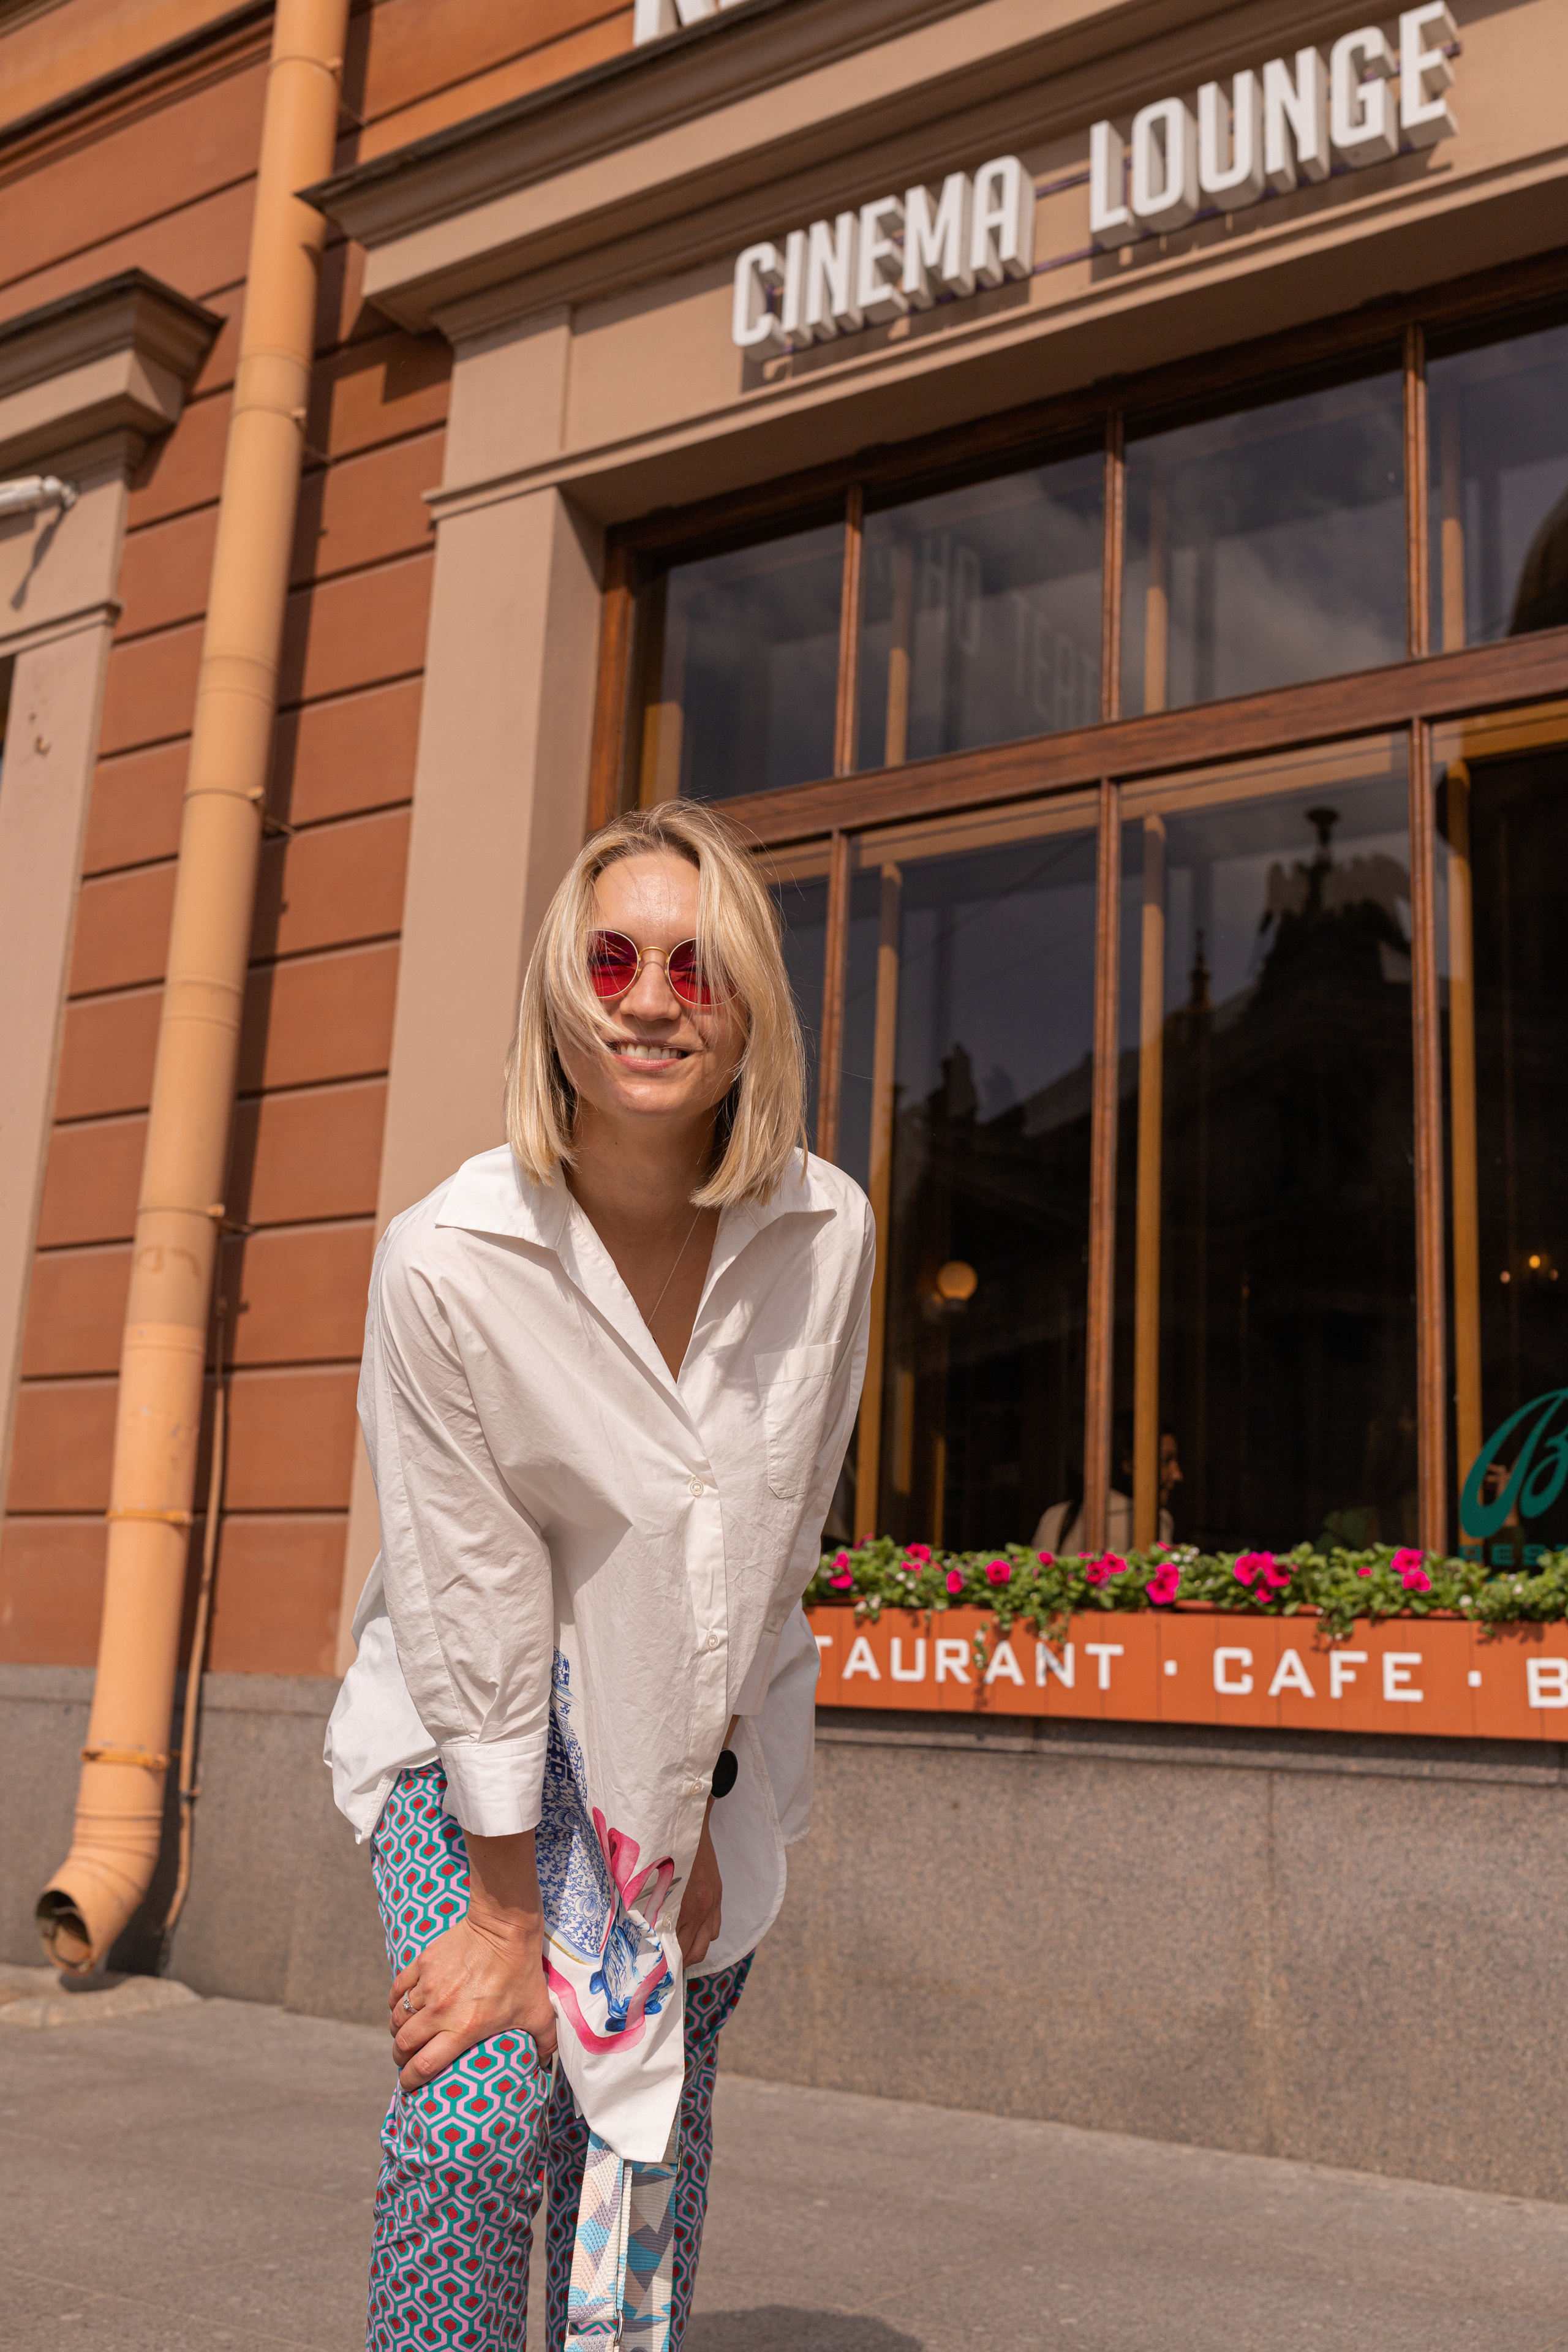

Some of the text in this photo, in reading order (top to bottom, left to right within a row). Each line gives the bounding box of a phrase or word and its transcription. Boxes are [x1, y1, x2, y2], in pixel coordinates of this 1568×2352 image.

[732, 0, 1454, 355] CINEMA LOUNGE
[1213, 1646, 1424, 1703] CAFE
